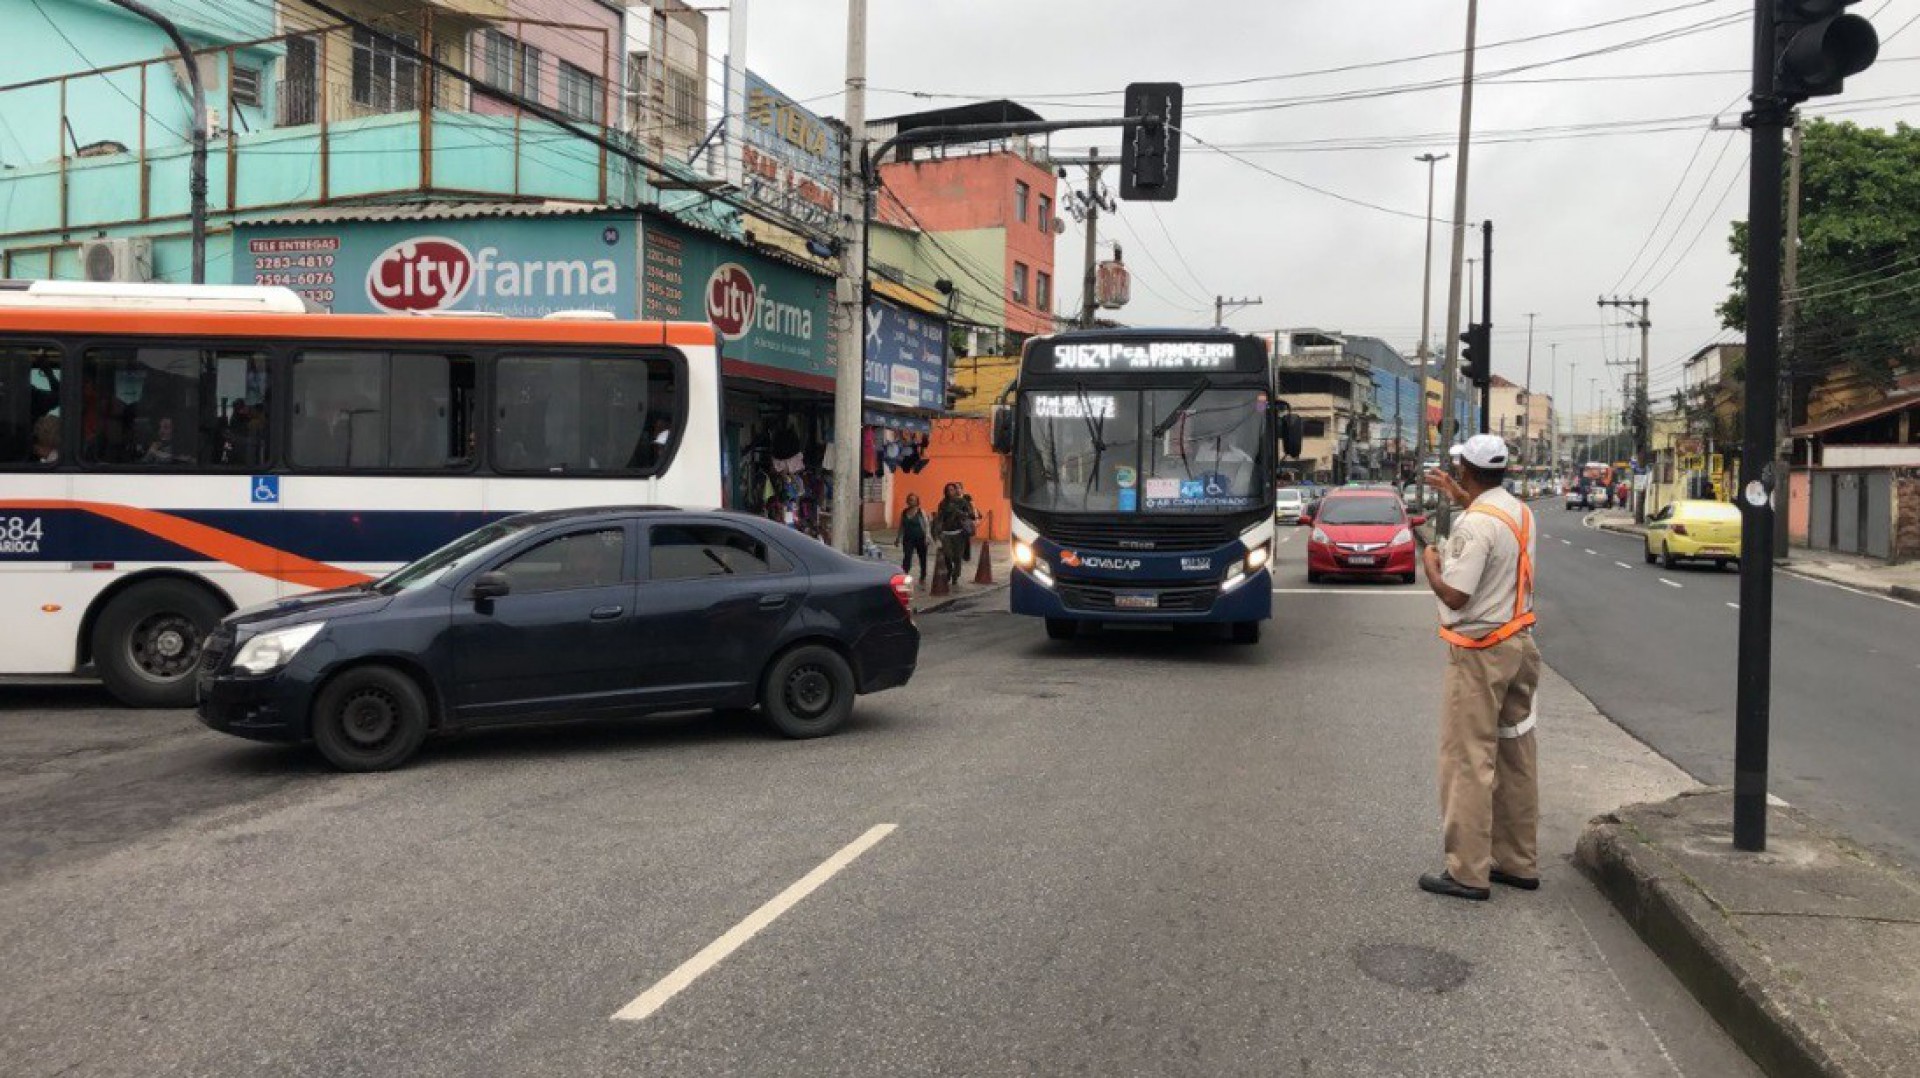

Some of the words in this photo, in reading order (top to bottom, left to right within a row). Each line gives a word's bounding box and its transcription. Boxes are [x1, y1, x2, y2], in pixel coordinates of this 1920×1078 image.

[252, 241, 276, 251] TELE
[279, 240, 336, 250] ENTREGAS
[255, 255, 334, 269] 3283-4819
[255, 272, 334, 286] 2594-6076
[1055, 344, 1110, 368] SV624
[0, 541, 40, 553] RIOCA
[1081, 557, 1141, 571] NOVACAP
